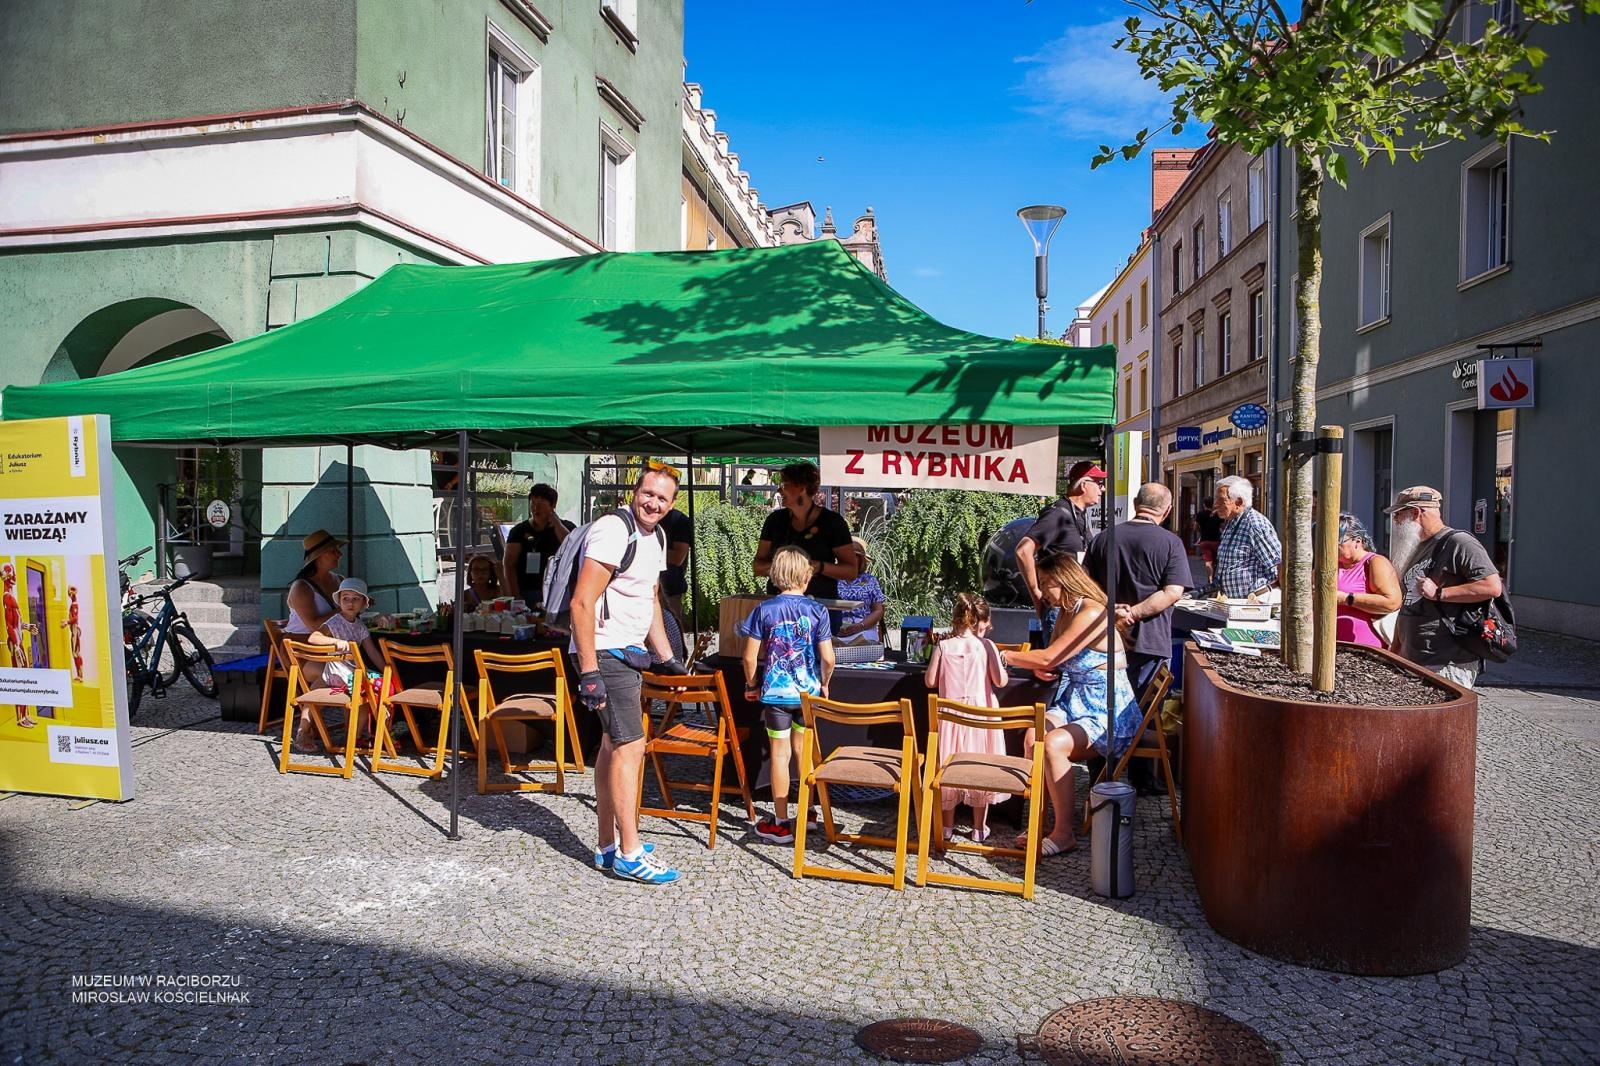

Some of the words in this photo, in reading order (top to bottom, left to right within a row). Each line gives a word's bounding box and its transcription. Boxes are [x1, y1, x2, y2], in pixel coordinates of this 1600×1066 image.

[867, 425, 1013, 450] MUZEUM
[1177, 434, 1199, 442] OPTYK
[845, 449, 865, 475] Z
[882, 450, 1030, 484] RYBNIKA
[4, 509, 88, 525] ZARAŻAMY
[5, 527, 67, 542] WIEDZĄ!
[74, 736, 109, 745] juliusz.eu
